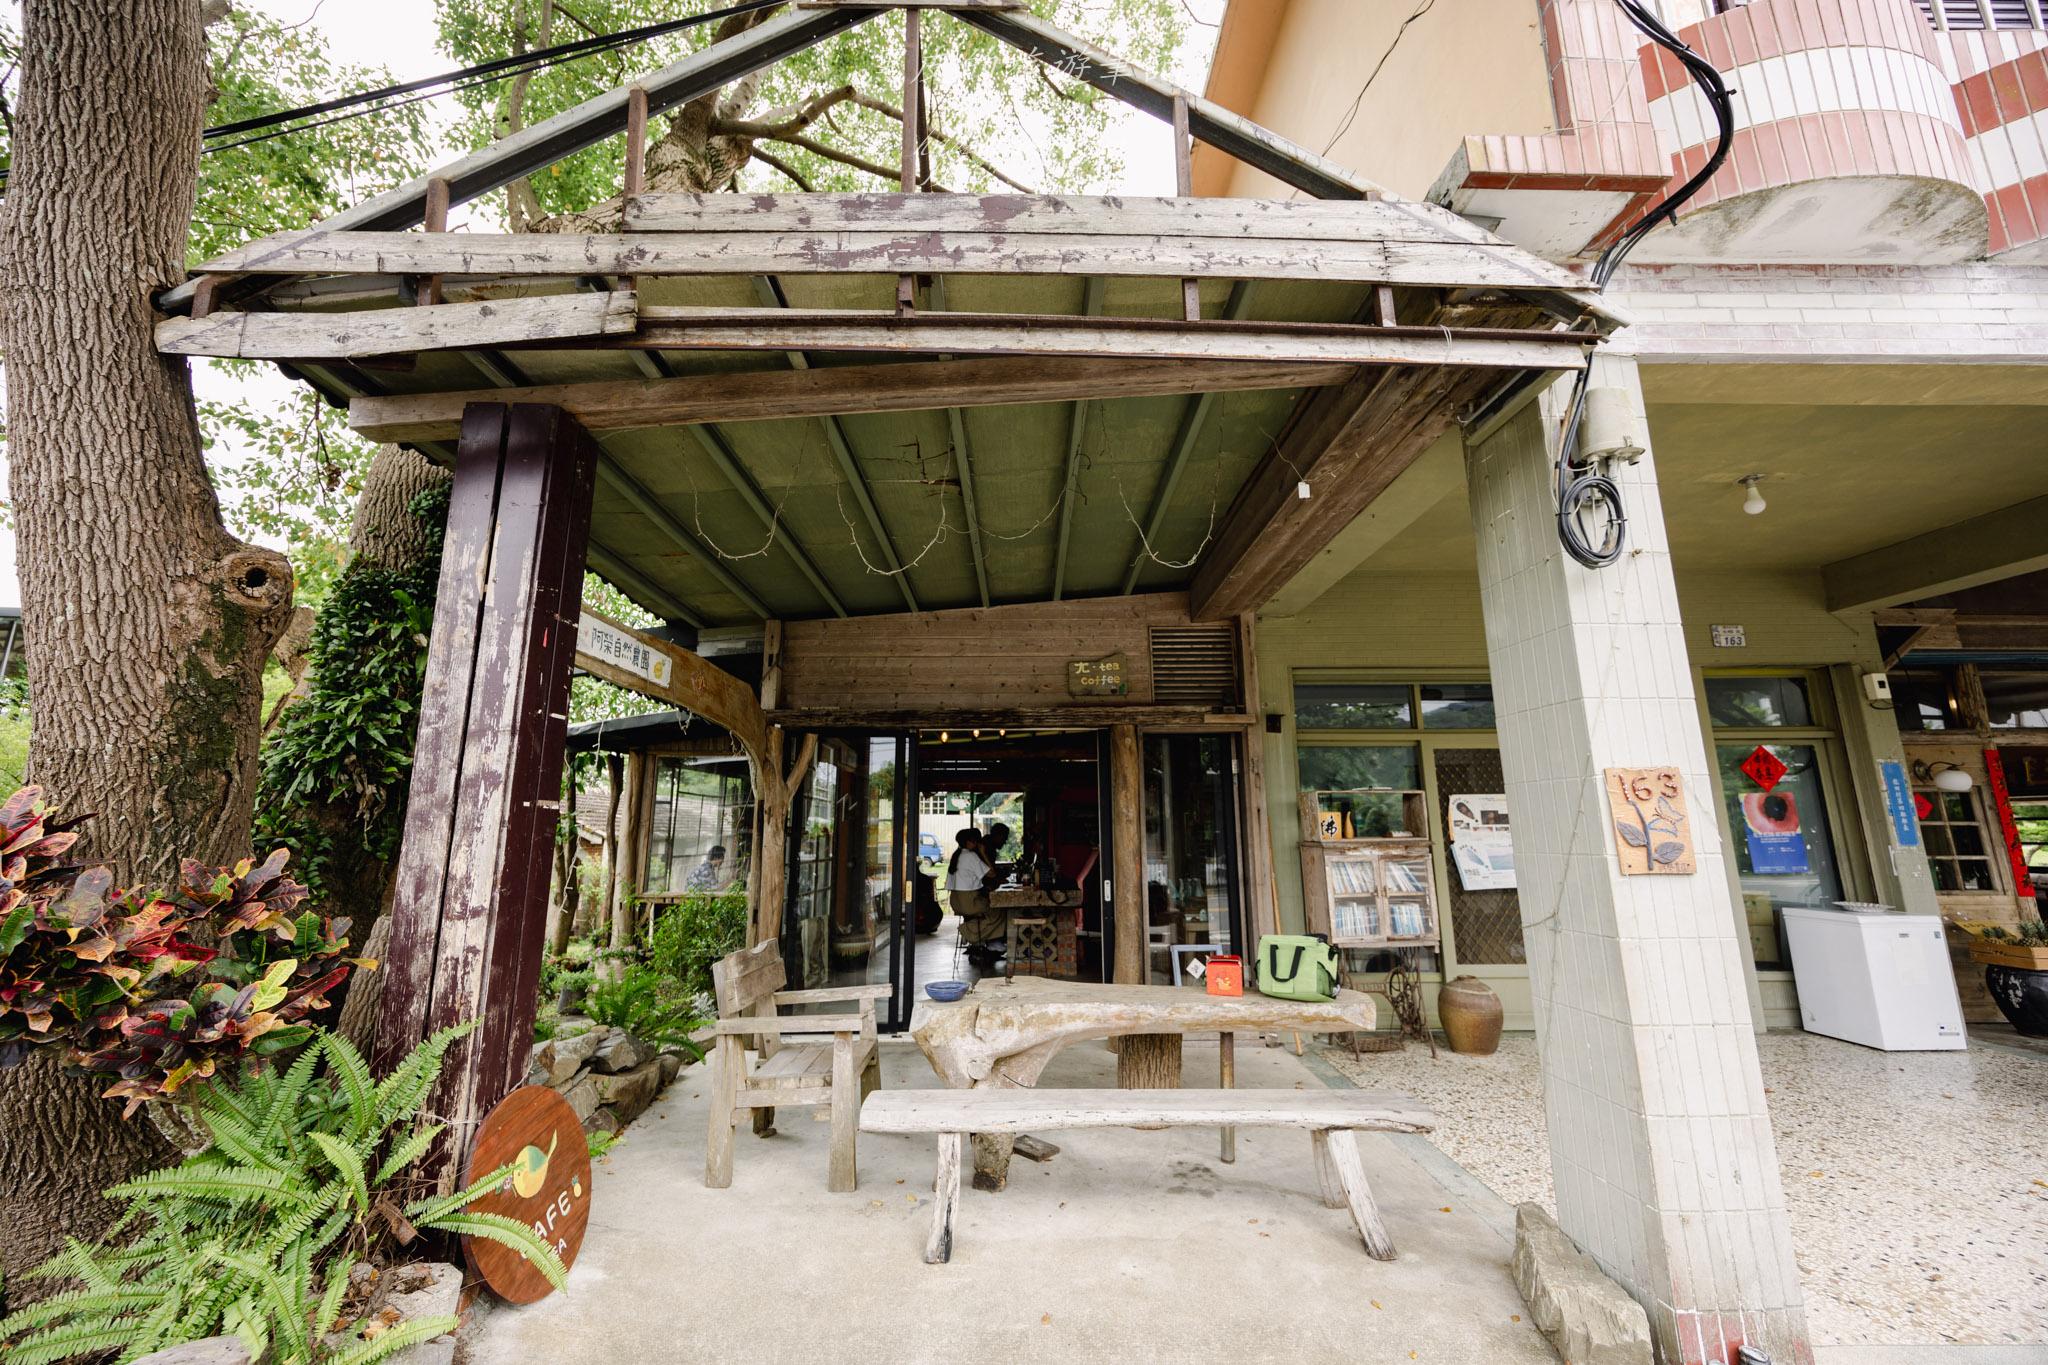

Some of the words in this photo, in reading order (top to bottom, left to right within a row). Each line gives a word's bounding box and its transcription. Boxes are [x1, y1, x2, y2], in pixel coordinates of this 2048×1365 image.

[1724, 636, 1743, 646] 163
[1099, 662, 1121, 671] tea
[1618, 771, 1679, 802] 163
[525, 1190, 571, 1251] AFE
